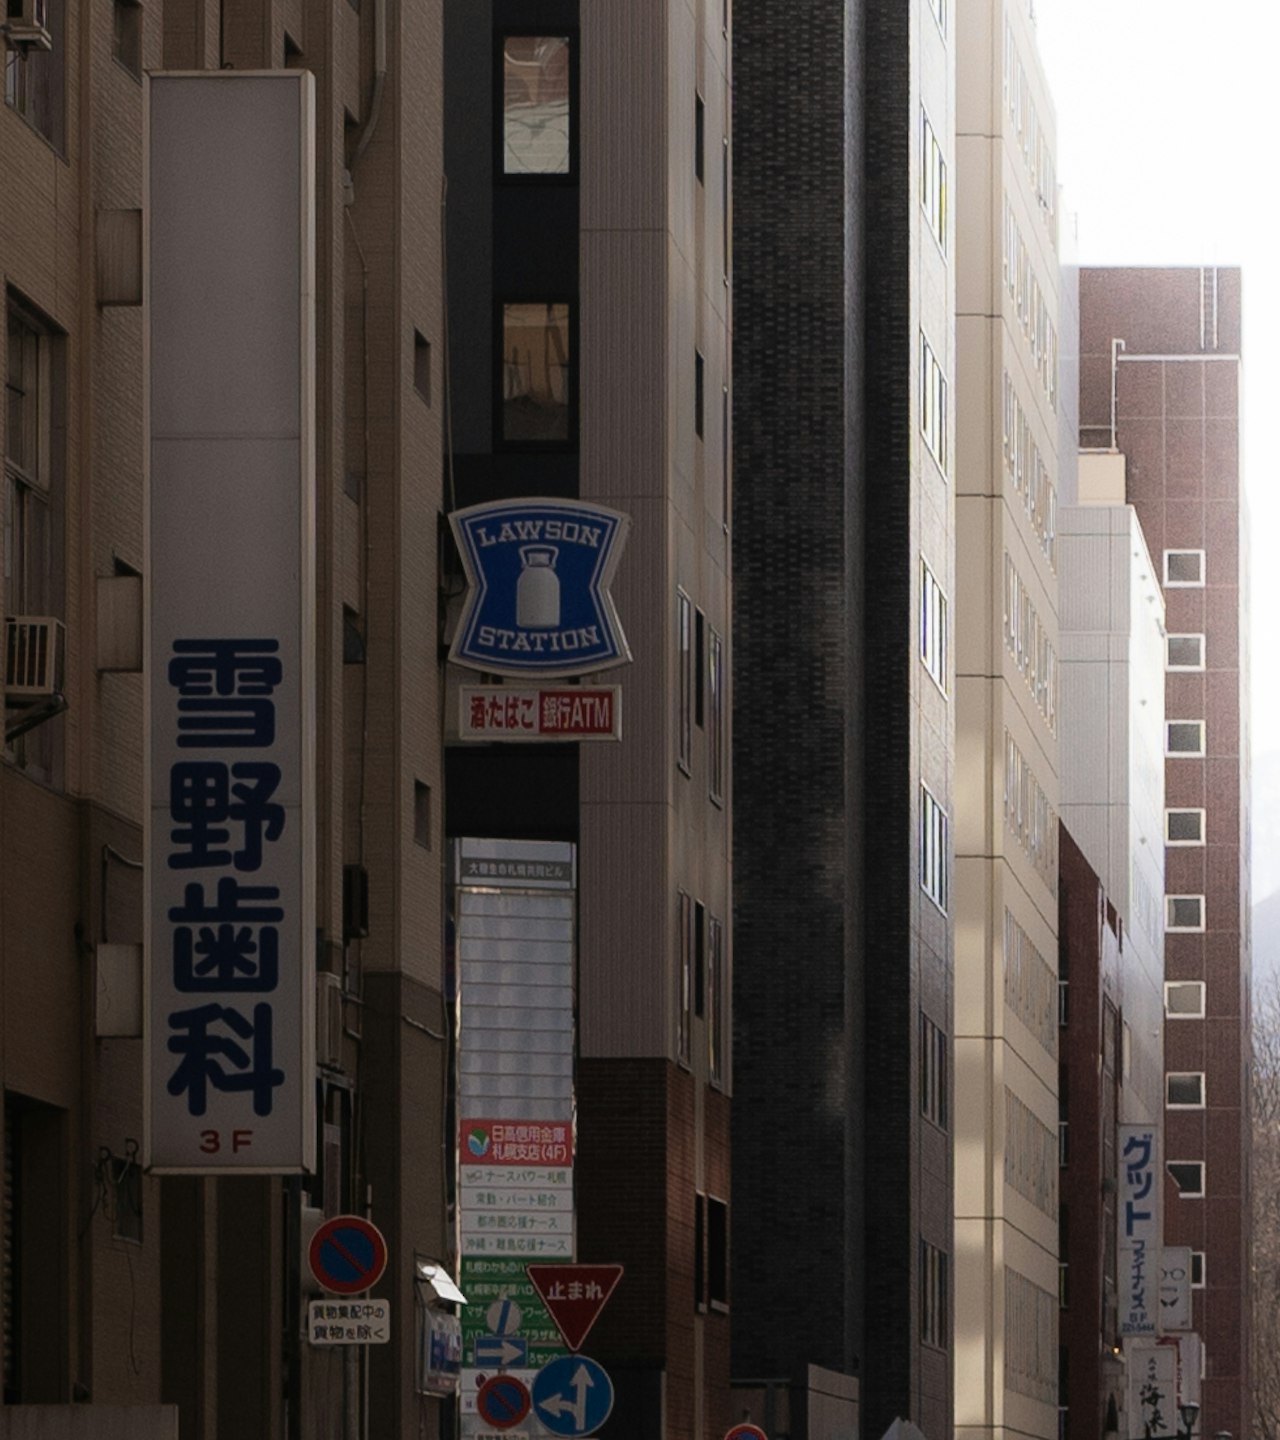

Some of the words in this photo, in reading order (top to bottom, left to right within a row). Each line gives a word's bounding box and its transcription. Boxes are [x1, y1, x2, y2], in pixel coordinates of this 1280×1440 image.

[477, 519, 602, 549] LAWSON
[478, 625, 601, 652] STATION
[543, 696, 610, 730] 銀行ATM
[166, 638, 287, 1117] 雪野歯科
[492, 1125, 566, 1143] 日高信用金庫
[486, 1171, 567, 1184] ナースパワー札幌
[546, 1279, 604, 1301] 止まれ
[313, 1304, 385, 1320] 貨物集配中の
[314, 1323, 385, 1340] 貨物を除く
